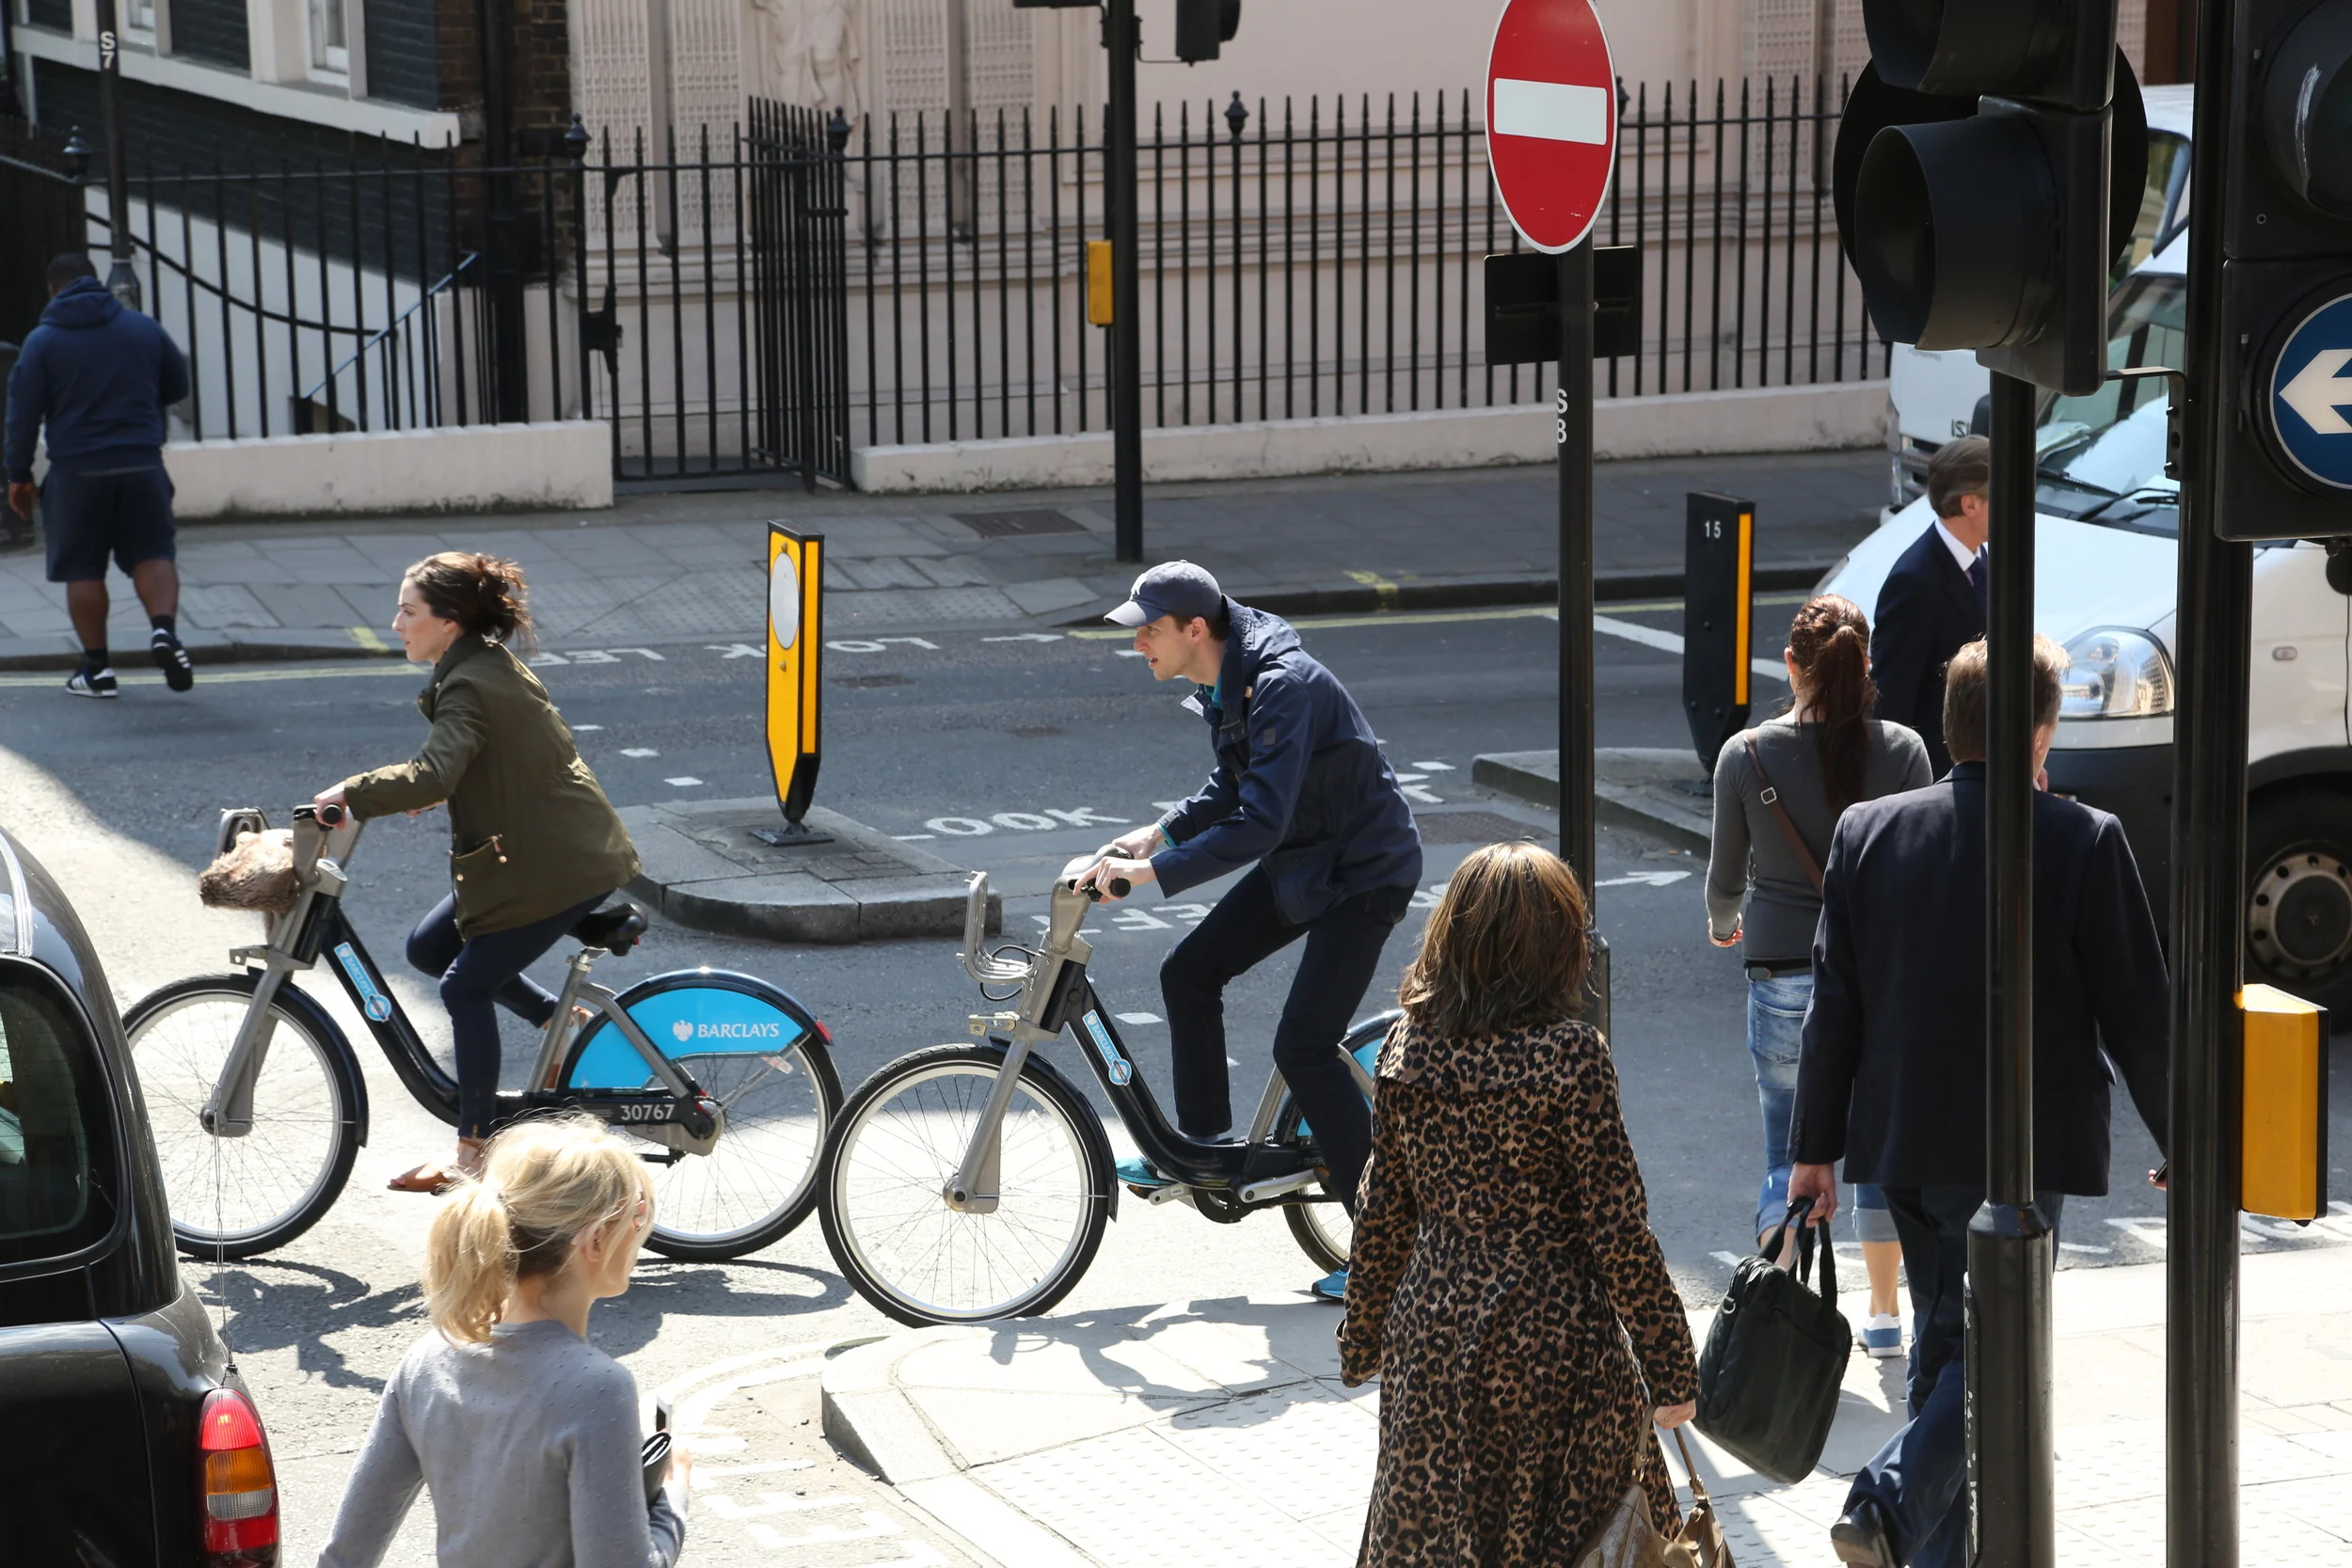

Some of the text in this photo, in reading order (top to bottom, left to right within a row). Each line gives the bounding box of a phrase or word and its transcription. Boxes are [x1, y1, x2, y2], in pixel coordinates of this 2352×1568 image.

[1705, 520, 1722, 539] 15
[697, 1023, 780, 1037] BARCLAYS
[1092, 1024, 1116, 1060] BARCLAYS
[620, 1104, 675, 1120] 30767
